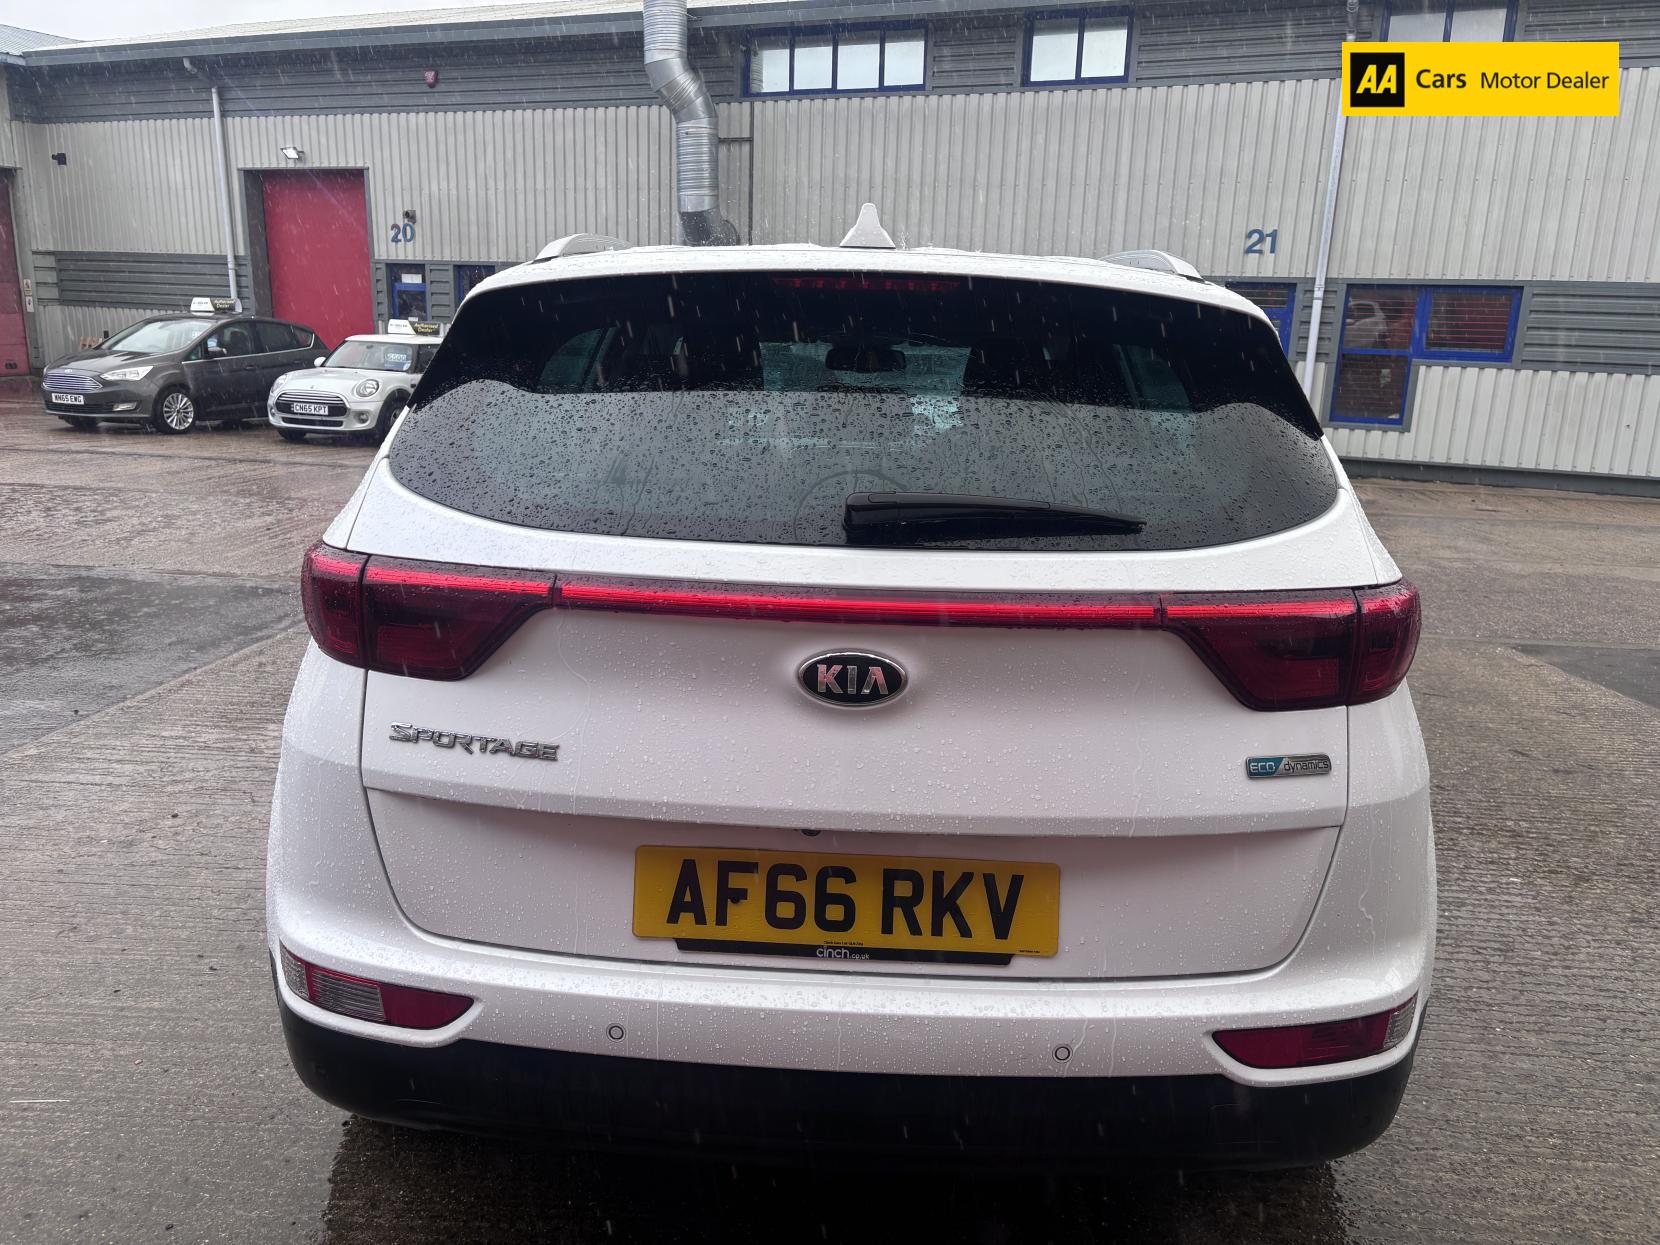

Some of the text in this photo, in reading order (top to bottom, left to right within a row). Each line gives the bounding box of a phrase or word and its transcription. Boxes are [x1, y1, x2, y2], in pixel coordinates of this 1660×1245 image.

[390, 223, 415, 243] 20
[1245, 228, 1278, 254] 21
[294, 404, 327, 414] CN65 KPT
[816, 663, 889, 695] KIA
[389, 722, 560, 762] SPORTAGE
[1249, 760, 1329, 773] ECO dynamics
[666, 858, 1025, 941] AF66 RKV
[816, 945, 870, 960] cinch.co.uk
